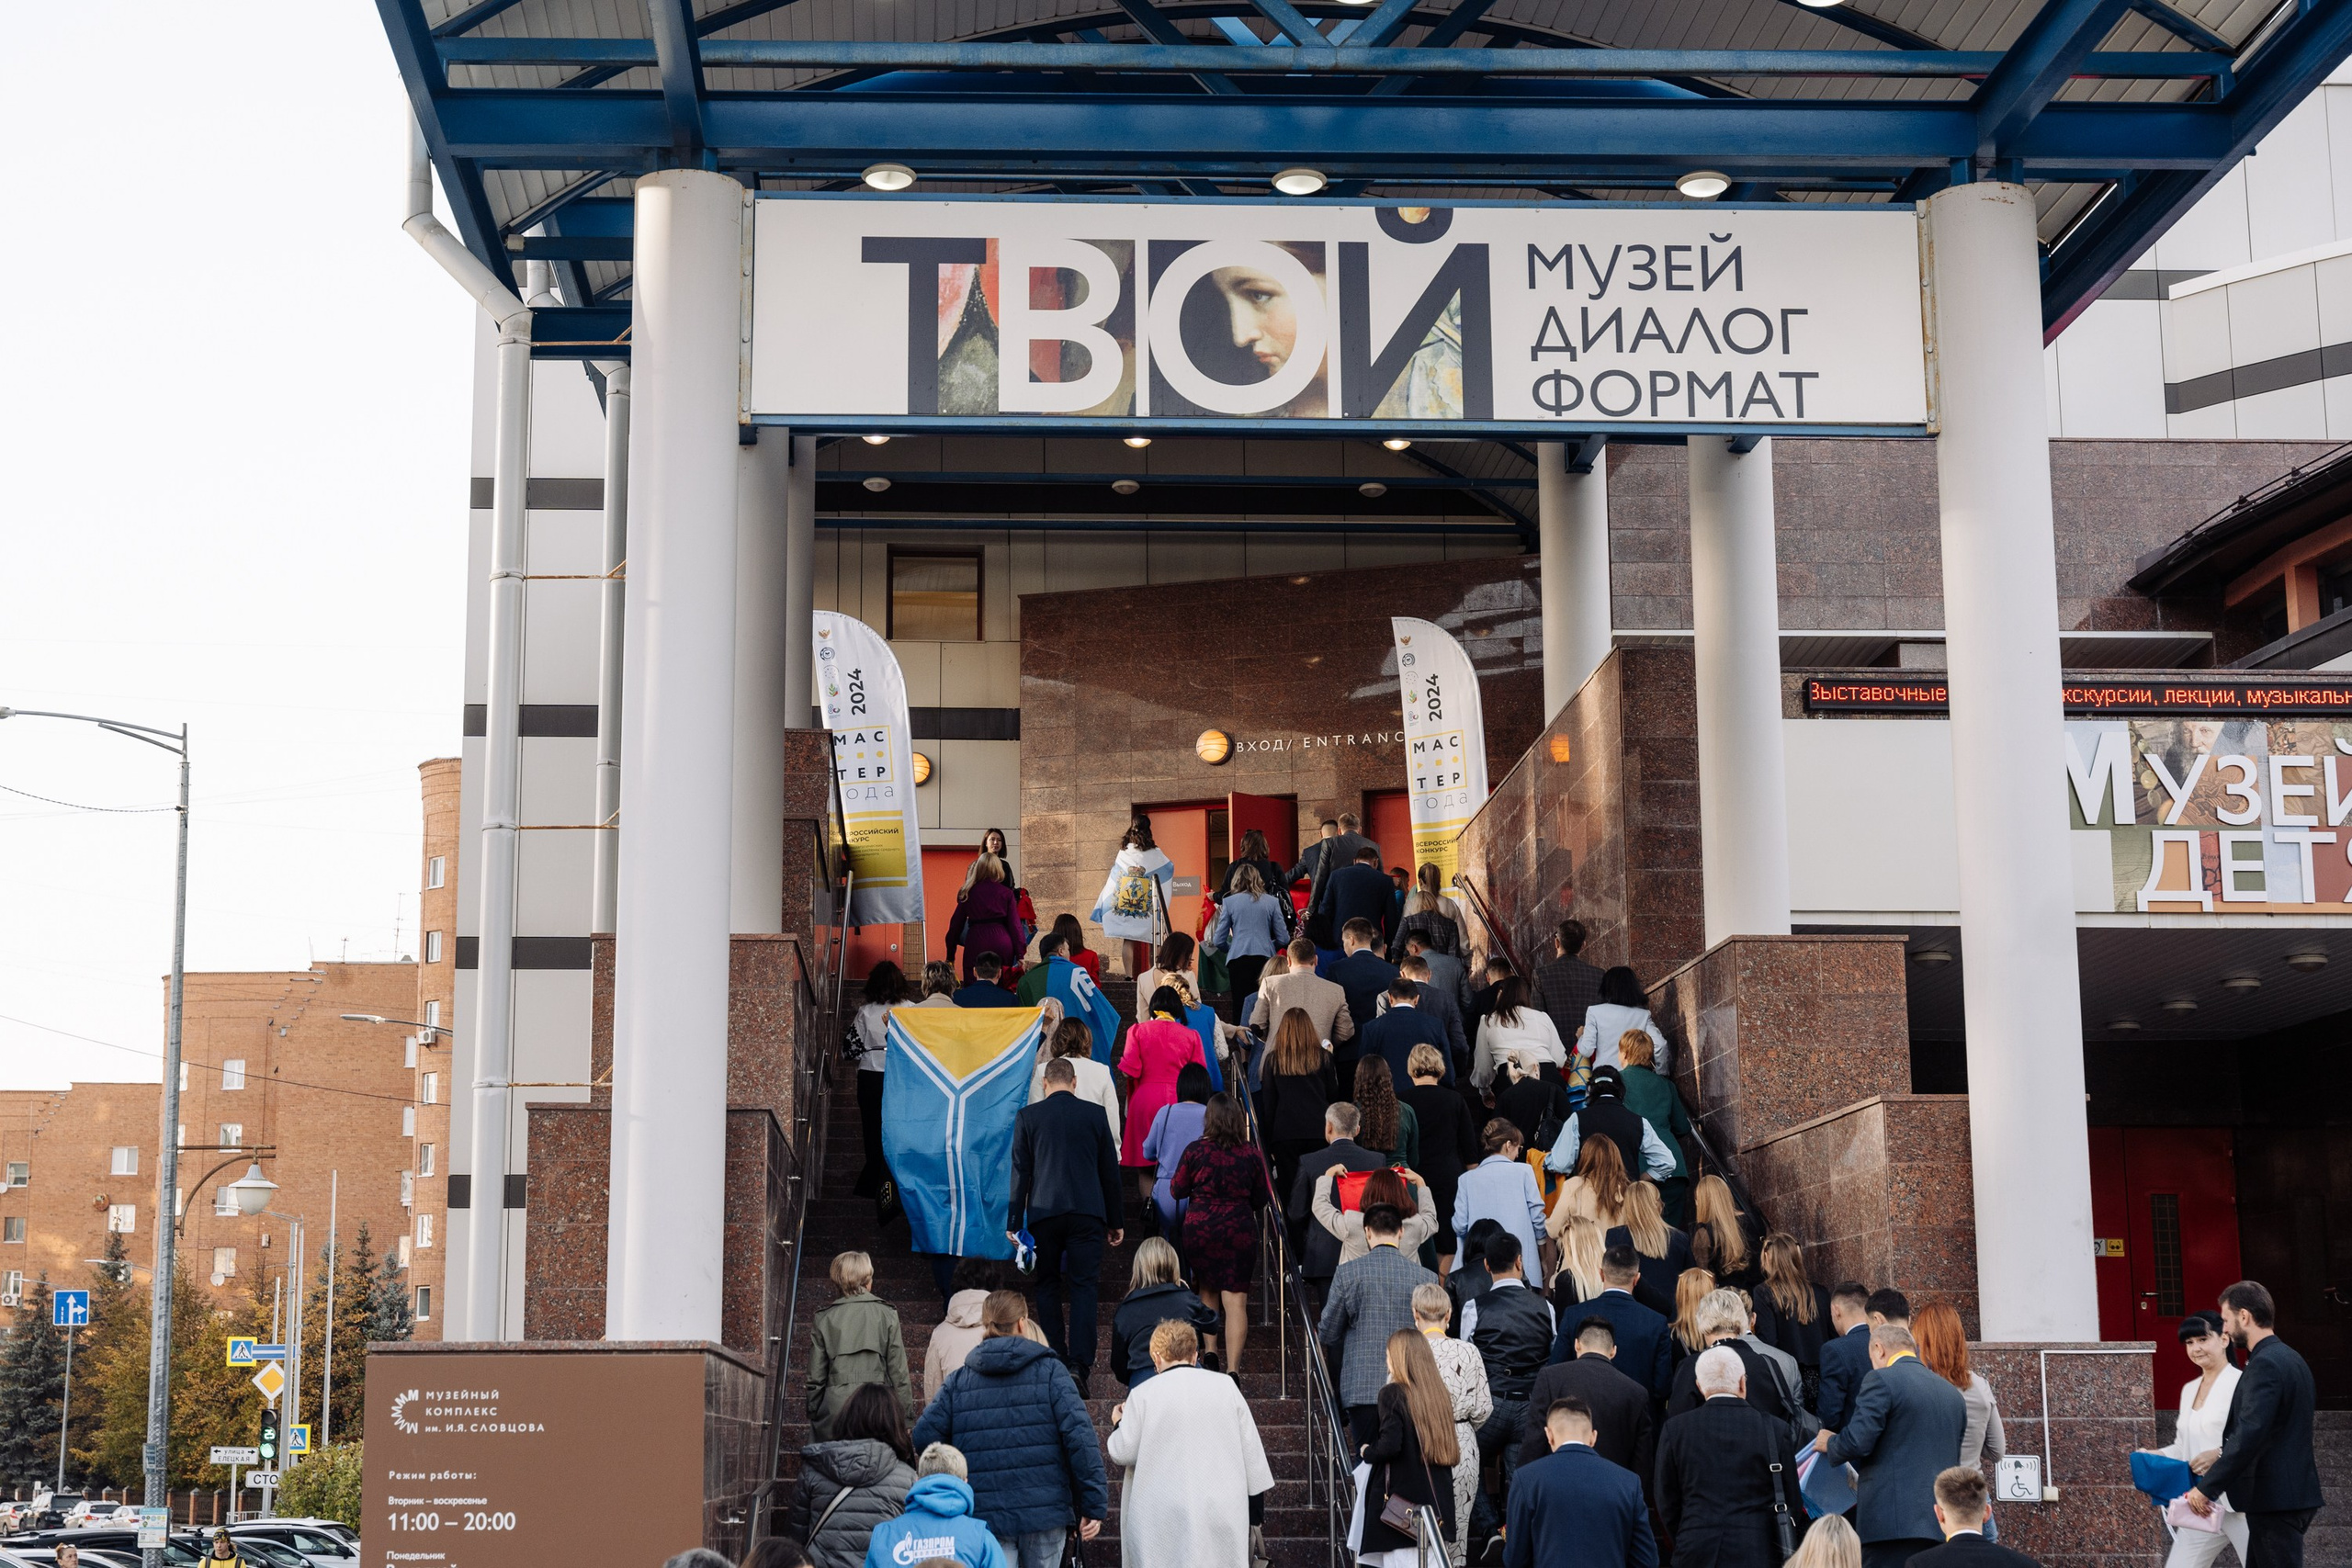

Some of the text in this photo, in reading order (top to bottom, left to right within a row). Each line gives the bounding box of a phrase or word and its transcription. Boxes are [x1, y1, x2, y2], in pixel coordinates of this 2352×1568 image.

[1527, 232, 1744, 299] МУЗЕЙ
[861, 208, 1494, 419] ТВОЙ
[1531, 306, 1808, 361] ДИАЛОГ
[1532, 368, 1819, 418] ФОРМАТ
[847, 668, 866, 716] 2024
[1426, 673, 1442, 721] 2024
[2063, 689, 2158, 706] кскурсии,
[2163, 689, 2241, 707] лекции,
[833, 730, 884, 746] МАС
[1237, 731, 1405, 752] ВХОД/ ENTRANC
[1413, 736, 1458, 754] МАС
[837, 766, 886, 780] ТЕР
[1417, 772, 1460, 789] ТЕР
[845, 785, 894, 801] ода
[1413, 792, 1467, 810] года
[847, 828, 899, 836] РОССИЙСКИЙ
[1416, 839, 1458, 847] ВСЕРОССИЙ
[2137, 829, 2352, 912] ДЕТ
[425, 1389, 499, 1401] МУЗЕЙНЫЙ
[425, 1407, 497, 1416] КОМПЛЕКС
[446, 1424, 467, 1432] И.Я.
[469, 1423, 545, 1433] СЛОВЦОВА
[253, 1474, 278, 1484] СТО
[389, 1471, 477, 1482] Режим работы:
[388, 1496, 424, 1506] Вторник
[434, 1497, 488, 1506] воскресенье
[388, 1512, 439, 1531] 11:00
[463, 1512, 516, 1531] 20:00
[913, 1536, 955, 1550] ГАЗПРОМ
[386, 1551, 446, 1561] Понедельник
